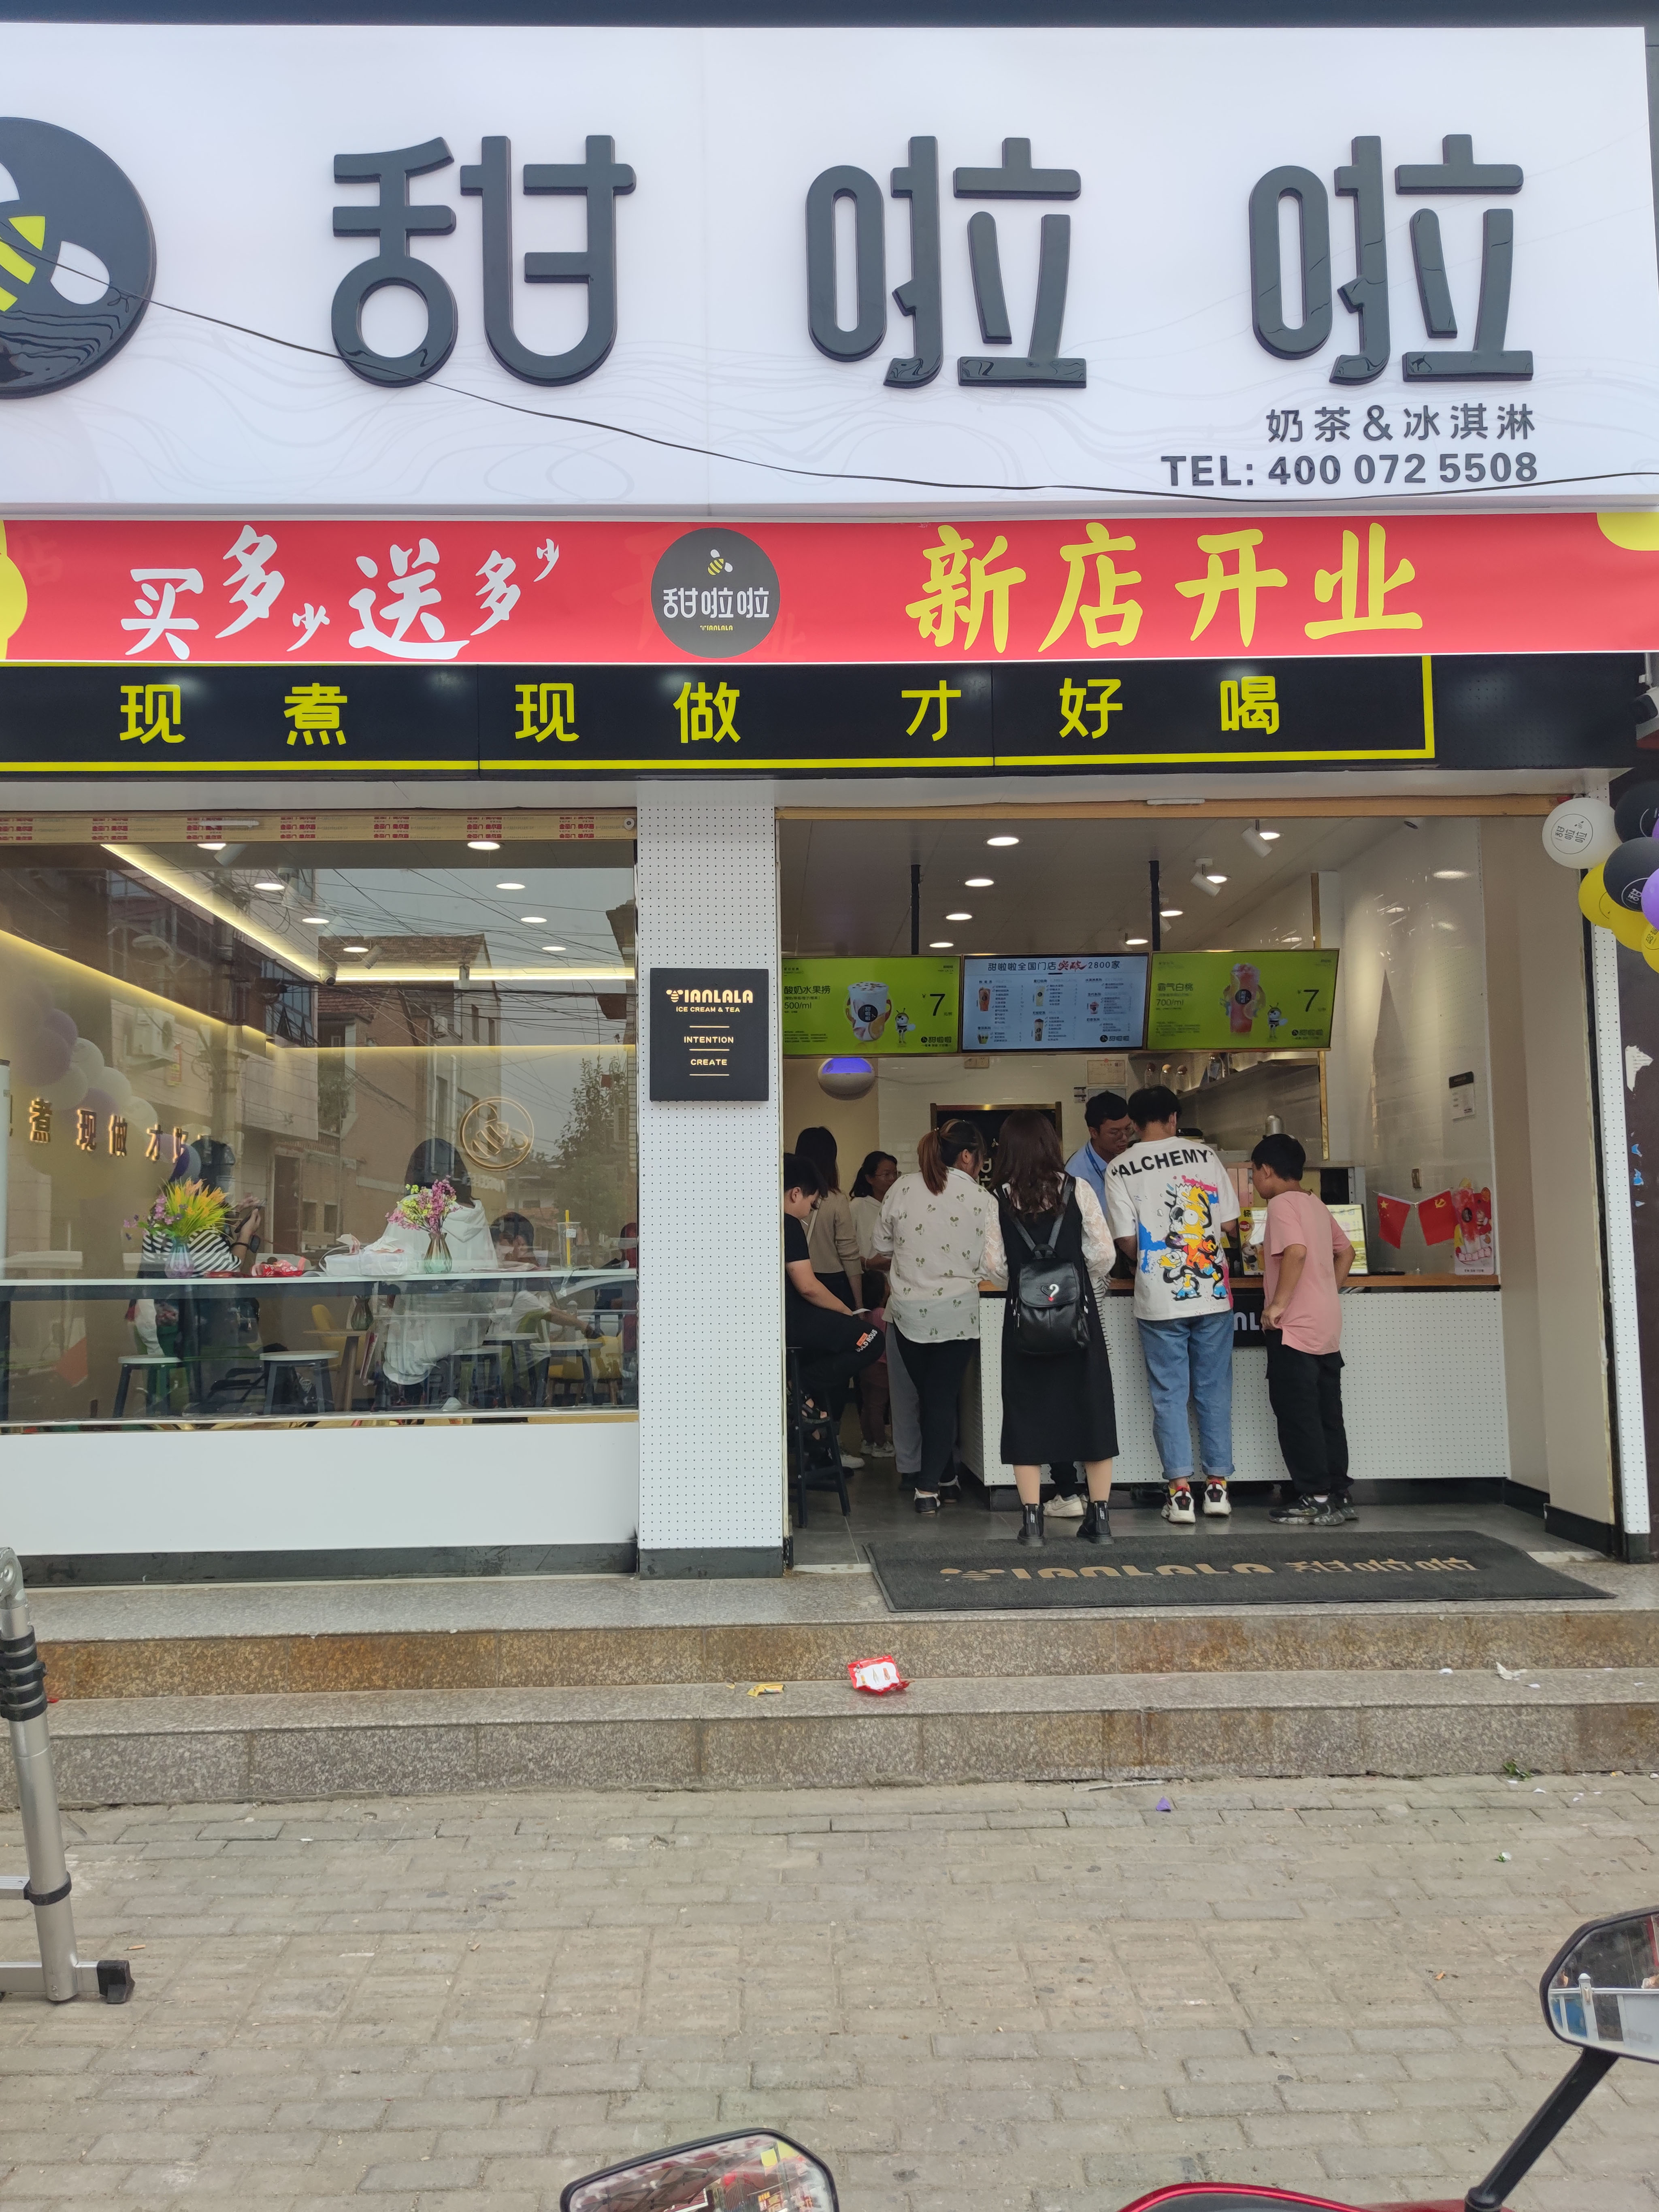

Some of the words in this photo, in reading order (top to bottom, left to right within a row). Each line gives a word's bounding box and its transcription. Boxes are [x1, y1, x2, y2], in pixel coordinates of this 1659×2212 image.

[331, 134, 1535, 389] 甜啦啦
[1266, 403, 1535, 443] 奶茶&冰淇淋
[1161, 455, 1254, 487] TEL:
[1268, 455, 1341, 485] 400
[1354, 454, 1426, 484] 072
[1440, 452, 1538, 484] 5508
[906, 523, 1423, 653] 新店开业
[663, 587, 770, 619] 甜啦啦
[1555, 826, 1587, 843] 甜啦啦
[784, 985, 831, 994] 酸奶水果捞
[1303, 989, 1320, 1012] 7
[929, 993, 946, 1016] 7
[684, 1036, 734, 1044] INTENTION
[1285, 1557, 1480, 1573] 甜啦啦
